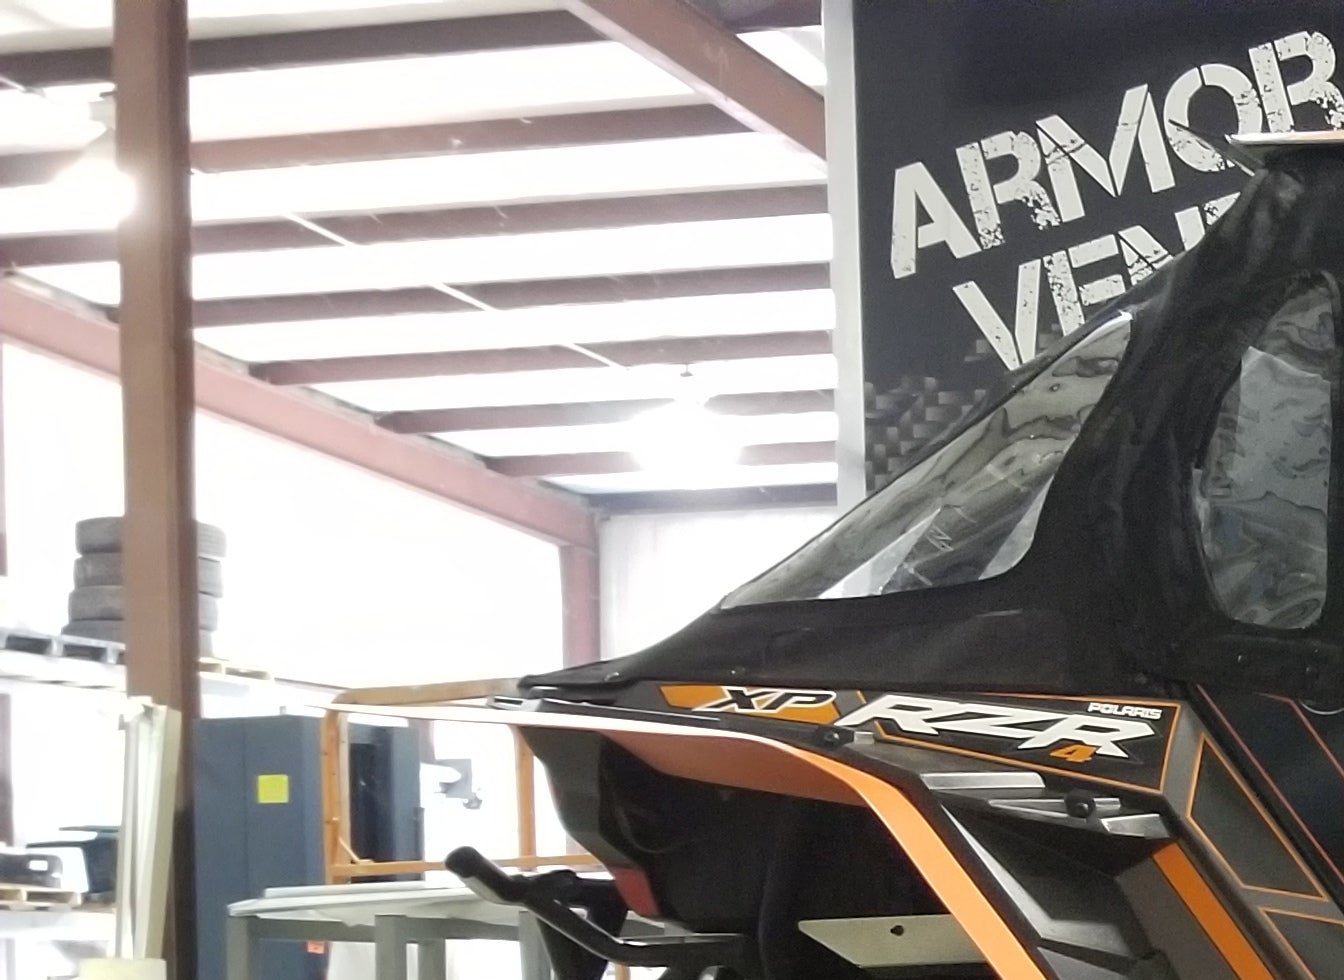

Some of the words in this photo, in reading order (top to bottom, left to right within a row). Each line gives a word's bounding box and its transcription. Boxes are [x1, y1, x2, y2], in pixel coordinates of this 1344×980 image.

[692, 687, 837, 714] XP
[1087, 702, 1162, 720] POLARIS
[833, 694, 1156, 758] RZR
[1049, 744, 1098, 763] 4
